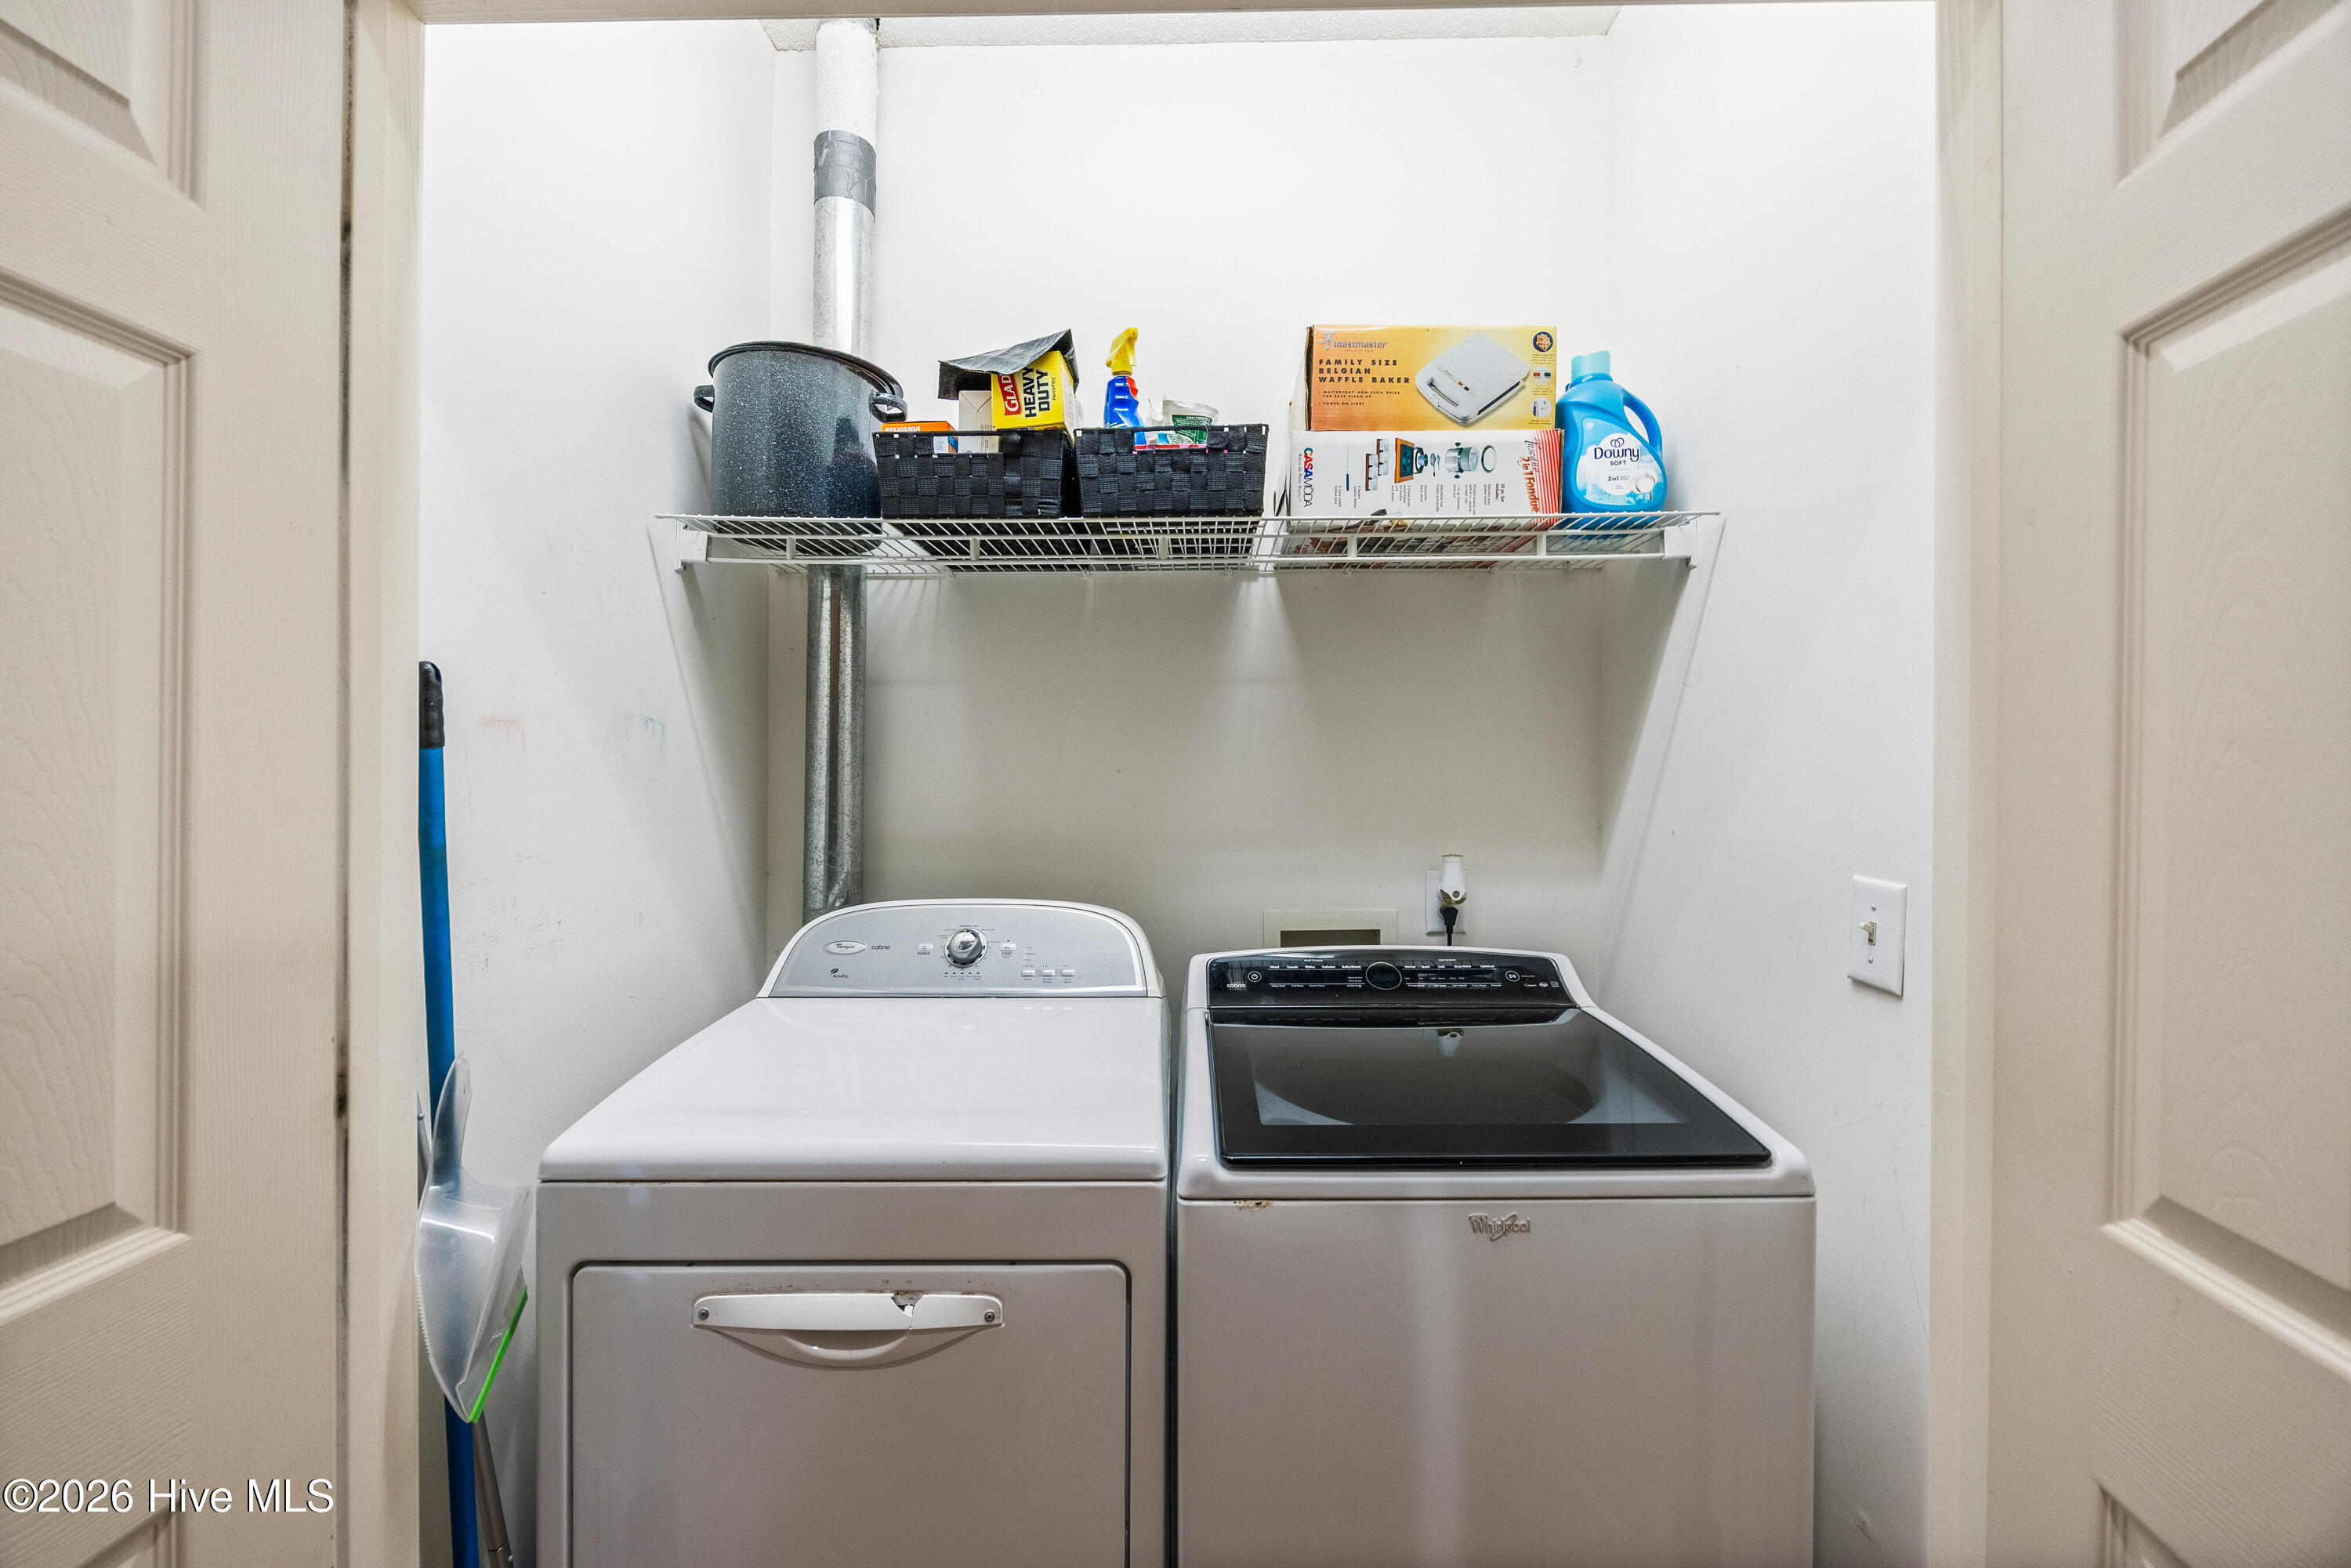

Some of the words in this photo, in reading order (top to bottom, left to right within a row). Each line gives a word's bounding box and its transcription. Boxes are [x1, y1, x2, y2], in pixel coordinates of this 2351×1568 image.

[1334, 340, 1387, 349] toastmaster
[1001, 375, 1019, 412] GLAD
[1023, 367, 1036, 418] HEAVY
[1036, 370, 1050, 411] DUTY
[1594, 447, 1639, 462] Downy
[1524, 477, 1539, 512] Fondue
[1469, 1214, 1531, 1240] Whirlpool
